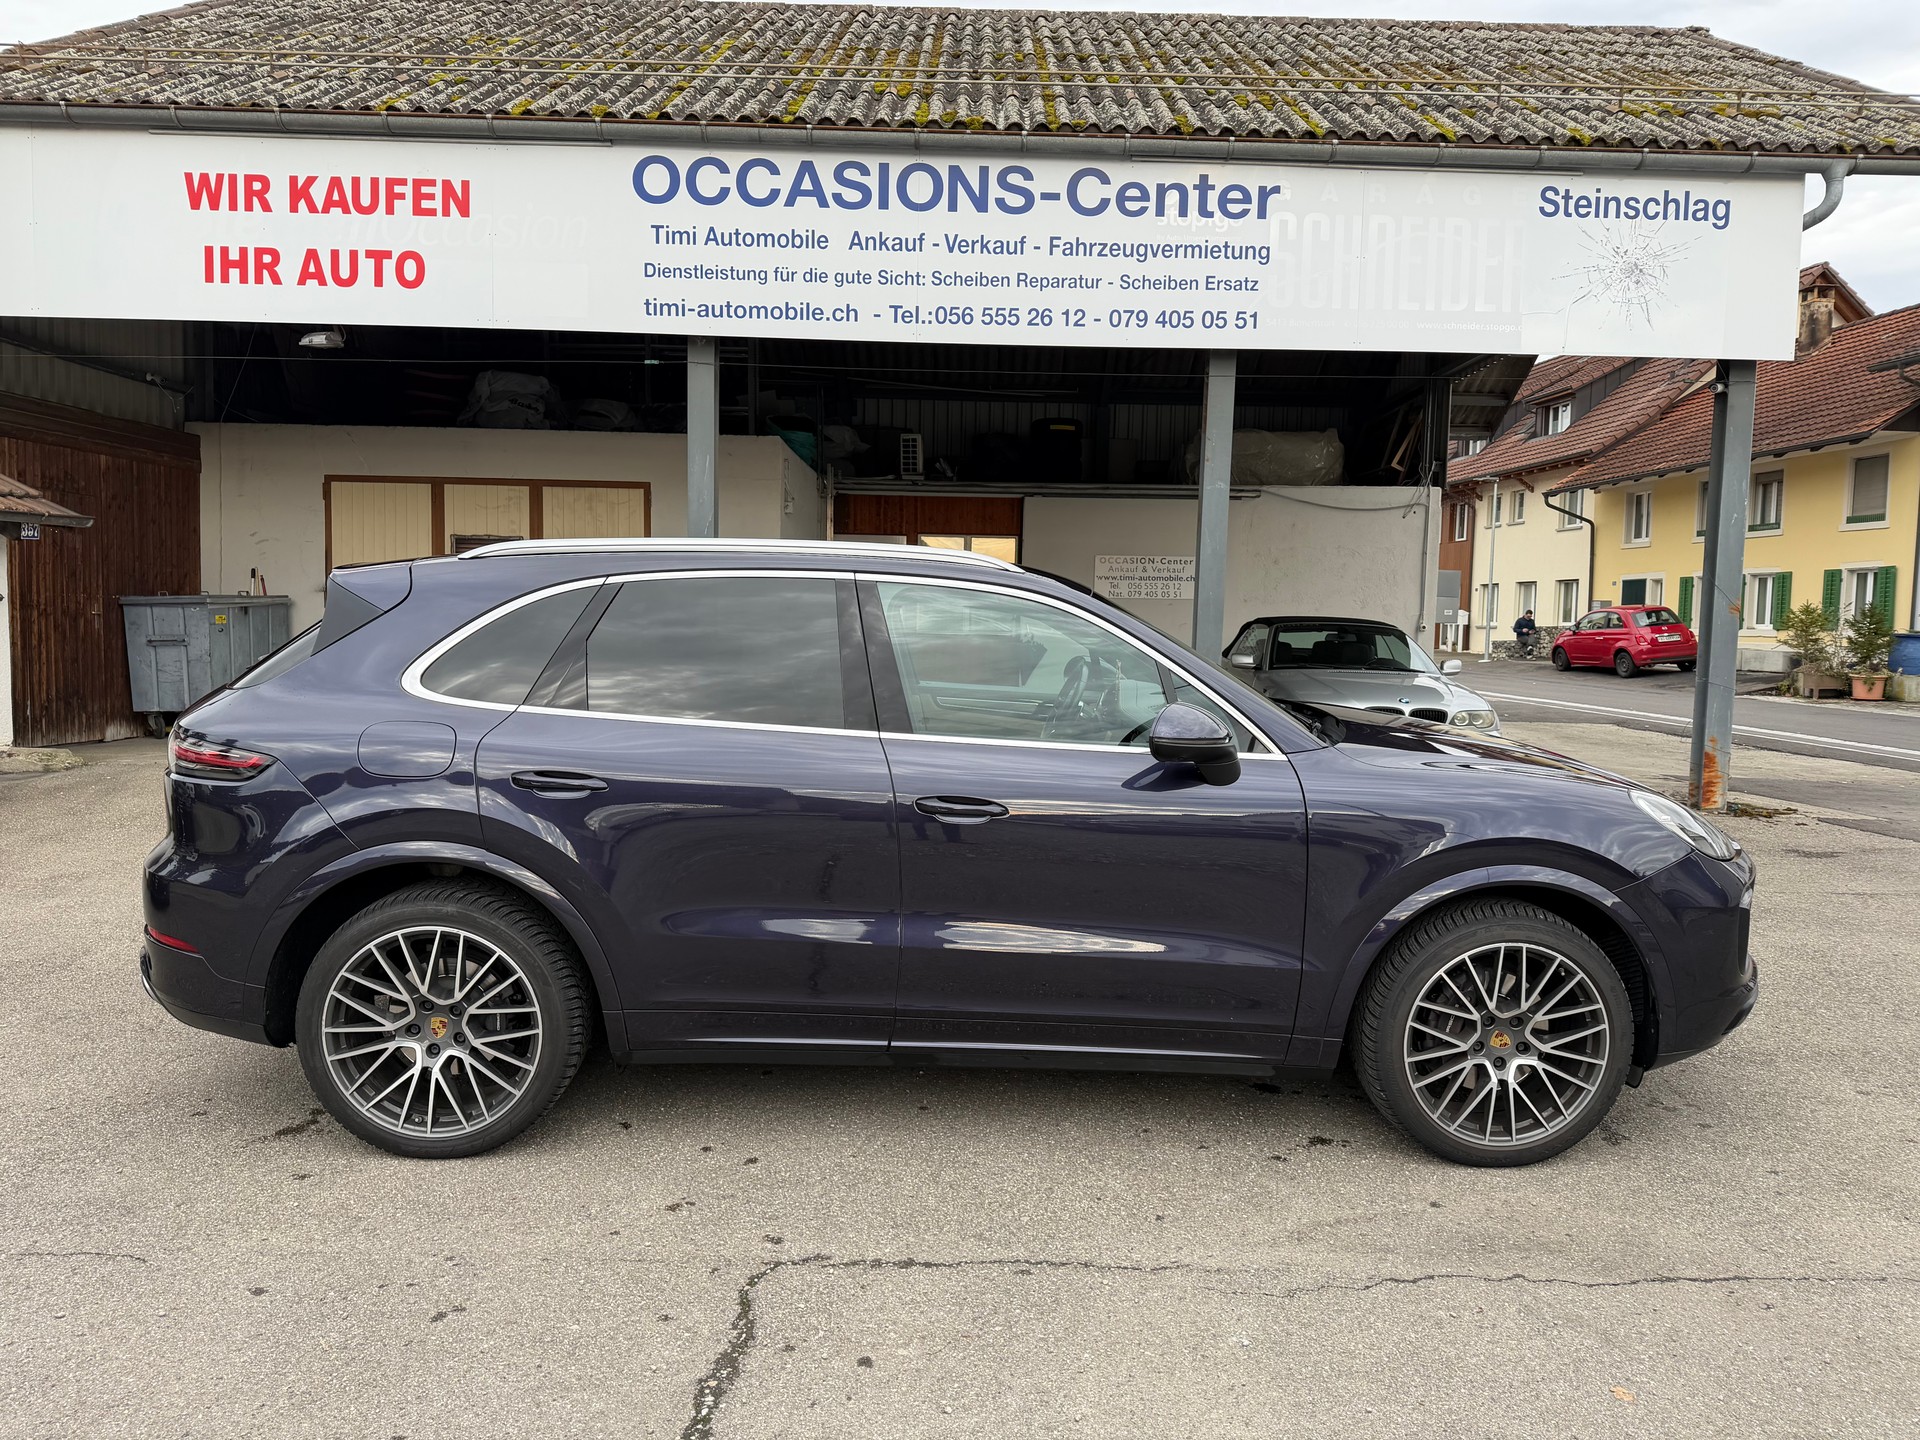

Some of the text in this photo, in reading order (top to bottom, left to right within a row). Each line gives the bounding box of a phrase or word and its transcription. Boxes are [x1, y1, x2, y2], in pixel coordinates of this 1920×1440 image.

[185, 172, 471, 218] WIR KAUFEN
[632, 155, 1281, 220] OCCASIONS-Center
[1539, 186, 1731, 230] Steinschlag
[651, 225, 696, 246] Timi
[704, 226, 829, 250] Automobile
[848, 231, 925, 253] Ankauf
[1049, 236, 1271, 266] Fahrzeugvermietung
[204, 246, 425, 289] IHR AUTO
[644, 263, 768, 285] Dienstleistung
[773, 267, 797, 283] für
[803, 268, 828, 284] die
[834, 270, 872, 288] gute
[878, 270, 926, 287] Sicht:
[931, 271, 1010, 288] Scheiben
[1017, 273, 1102, 291] Reparatur
[1120, 274, 1198, 291] Scheiben
[1205, 276, 1258, 292] Ersatz
[644, 298, 858, 323] timi-automobile.ch
[981, 307, 1020, 327] 555
[1027, 308, 1053, 327] 26
[1061, 309, 1085, 328] 12
[1109, 309, 1148, 329] 079
[1155, 310, 1194, 329] 405
[1202, 311, 1227, 330] 05
[1235, 311, 1258, 330] 51
[1100, 557, 1193, 565] OCCASION-Center
